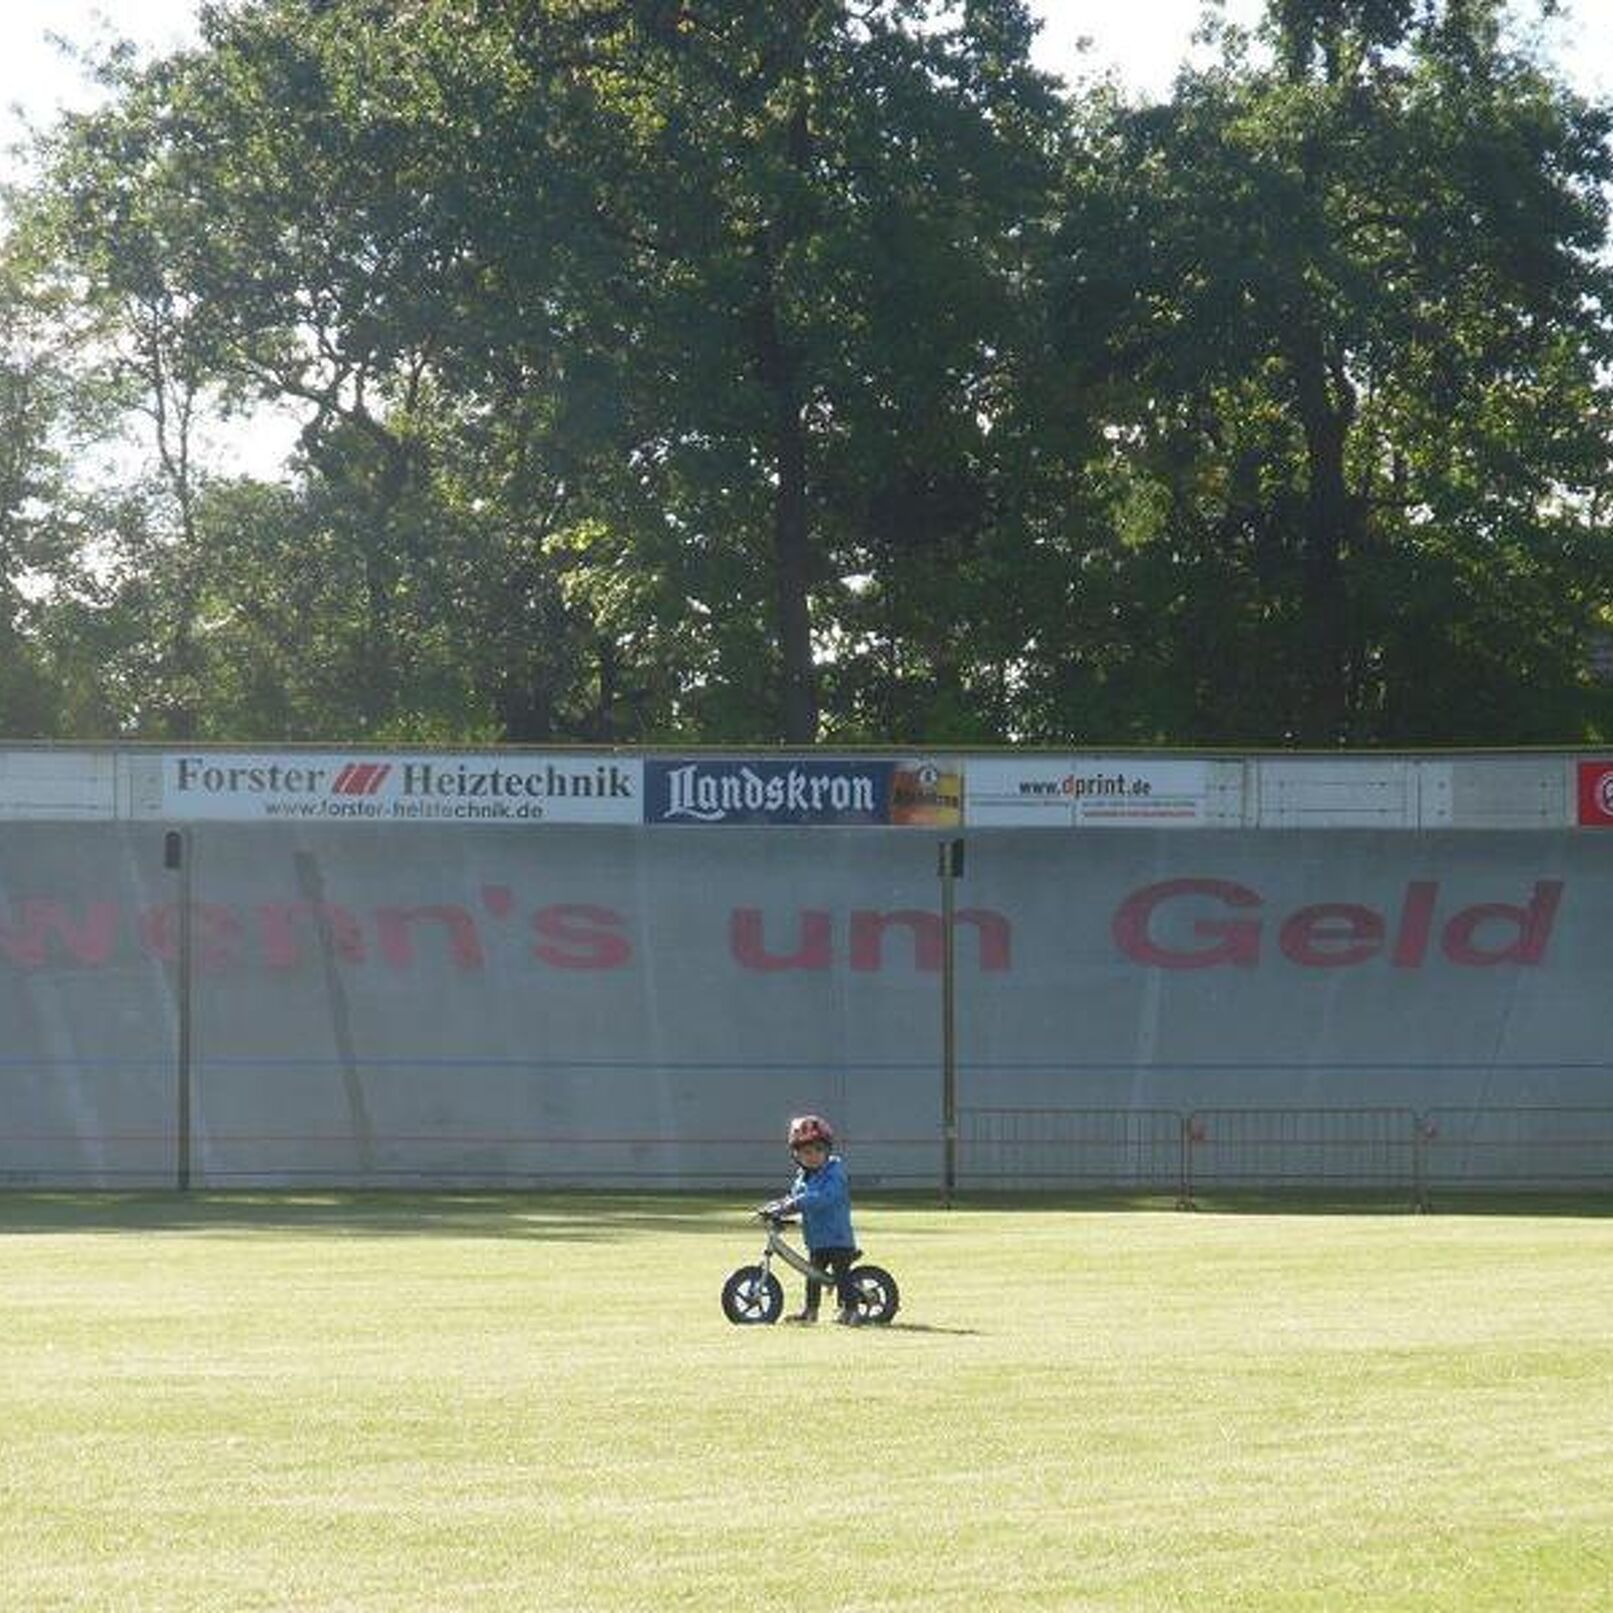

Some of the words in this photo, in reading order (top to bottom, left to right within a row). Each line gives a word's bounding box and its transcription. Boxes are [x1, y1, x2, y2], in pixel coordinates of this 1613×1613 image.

[177, 758, 325, 793] Forster
[402, 763, 632, 797] Heiztechnik
[663, 764, 875, 821] Landskron
[1018, 773, 1152, 798] www.dprint.de
[728, 904, 1013, 973] um
[1112, 877, 1566, 972] Geld
